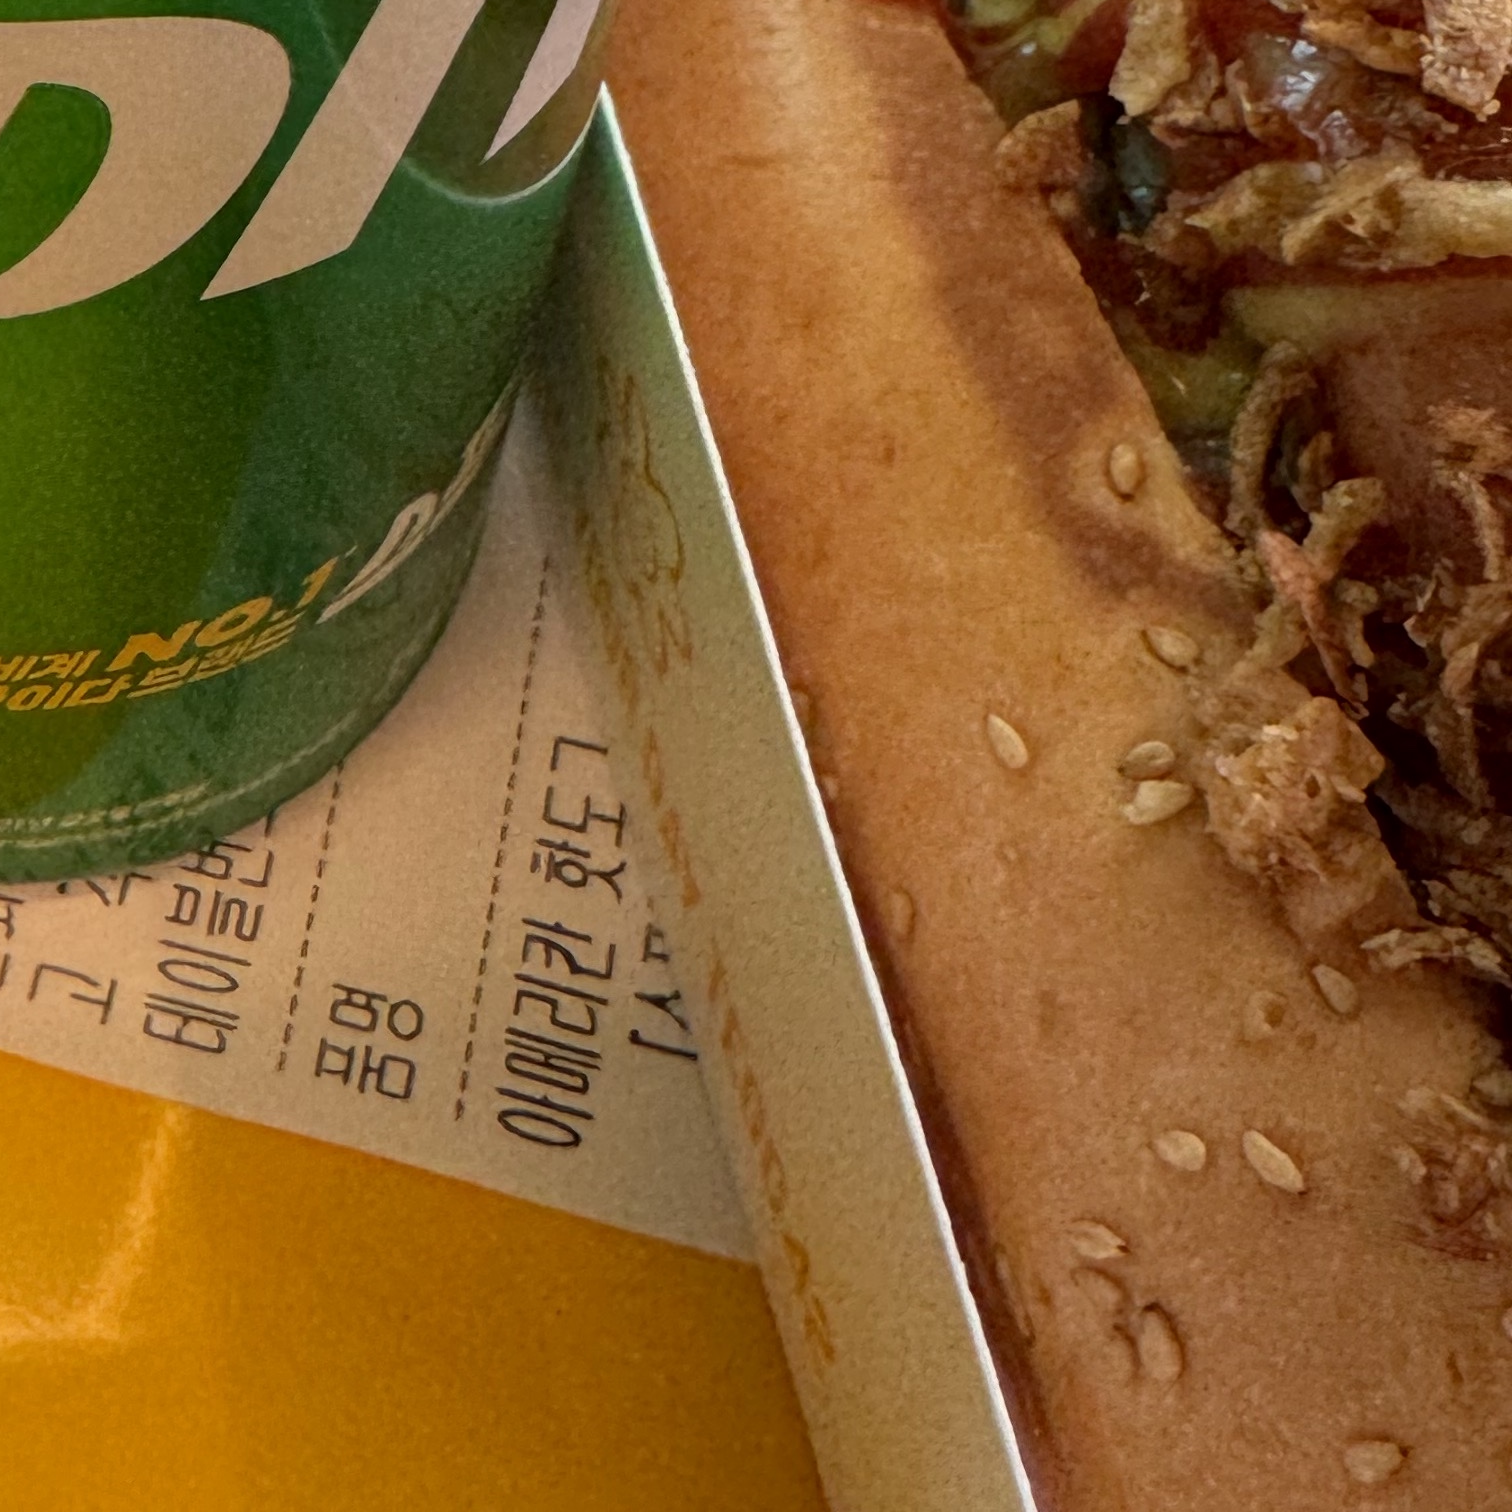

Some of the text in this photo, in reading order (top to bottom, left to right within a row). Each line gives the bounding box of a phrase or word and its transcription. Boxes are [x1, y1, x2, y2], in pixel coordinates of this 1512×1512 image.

[127, 610, 306, 700] 브랜드
[143, 802, 276, 1055] 테이블번
[314, 983, 425, 1100] 품명
[494, 917, 617, 1148] 아메리칸
